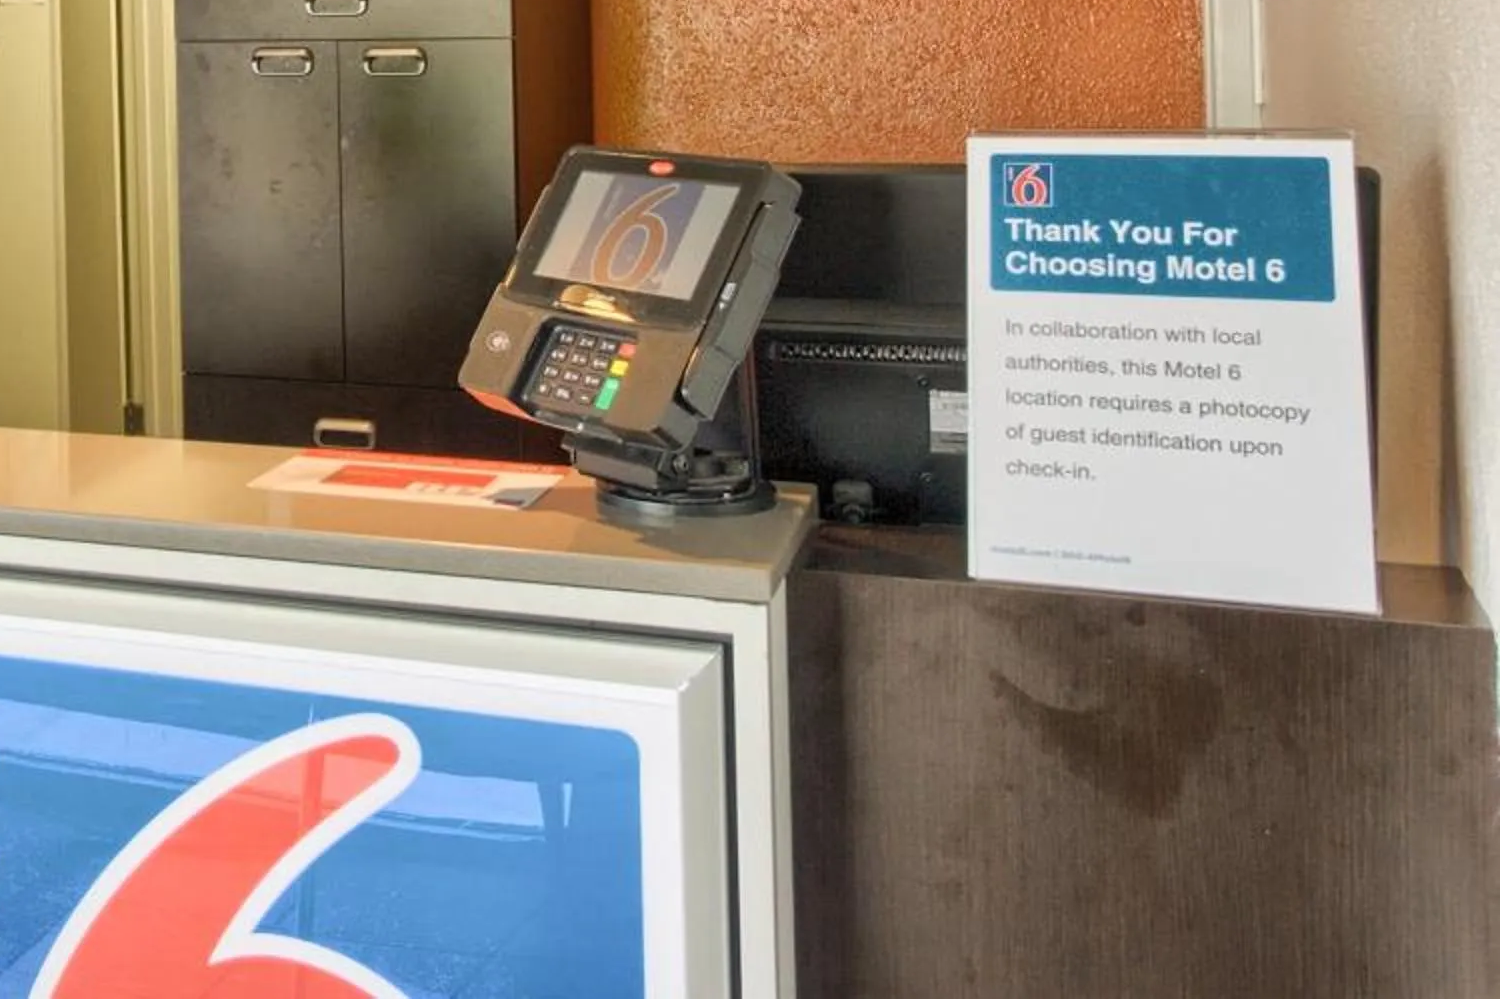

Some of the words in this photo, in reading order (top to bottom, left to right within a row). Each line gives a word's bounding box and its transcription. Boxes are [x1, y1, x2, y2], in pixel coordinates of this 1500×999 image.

[1004, 217, 1100, 243] Thank
[1110, 220, 1172, 245] You
[1183, 221, 1238, 246] For
[1005, 251, 1156, 283] Choosing
[1167, 254, 1255, 281] Motel
[1265, 258, 1285, 282] 6
[1005, 319, 1023, 336] In
[1029, 320, 1157, 342] collaboration
[1165, 327, 1206, 344] with
[1212, 328, 1261, 346] local
[1005, 354, 1115, 377] authorities,
[1121, 359, 1157, 376] this
[1164, 360, 1221, 379] Motel
[1228, 364, 1241, 380] 6
[1006, 388, 1082, 408] location
[1089, 392, 1173, 414] requires
[1179, 402, 1192, 414] a
[1199, 398, 1311, 425] photocopy
[1005, 423, 1025, 440] of
[1030, 426, 1085, 446] guest
[1092, 428, 1222, 453] identification
[1230, 440, 1283, 457] upon
[1006, 459, 1096, 480] check-in.
